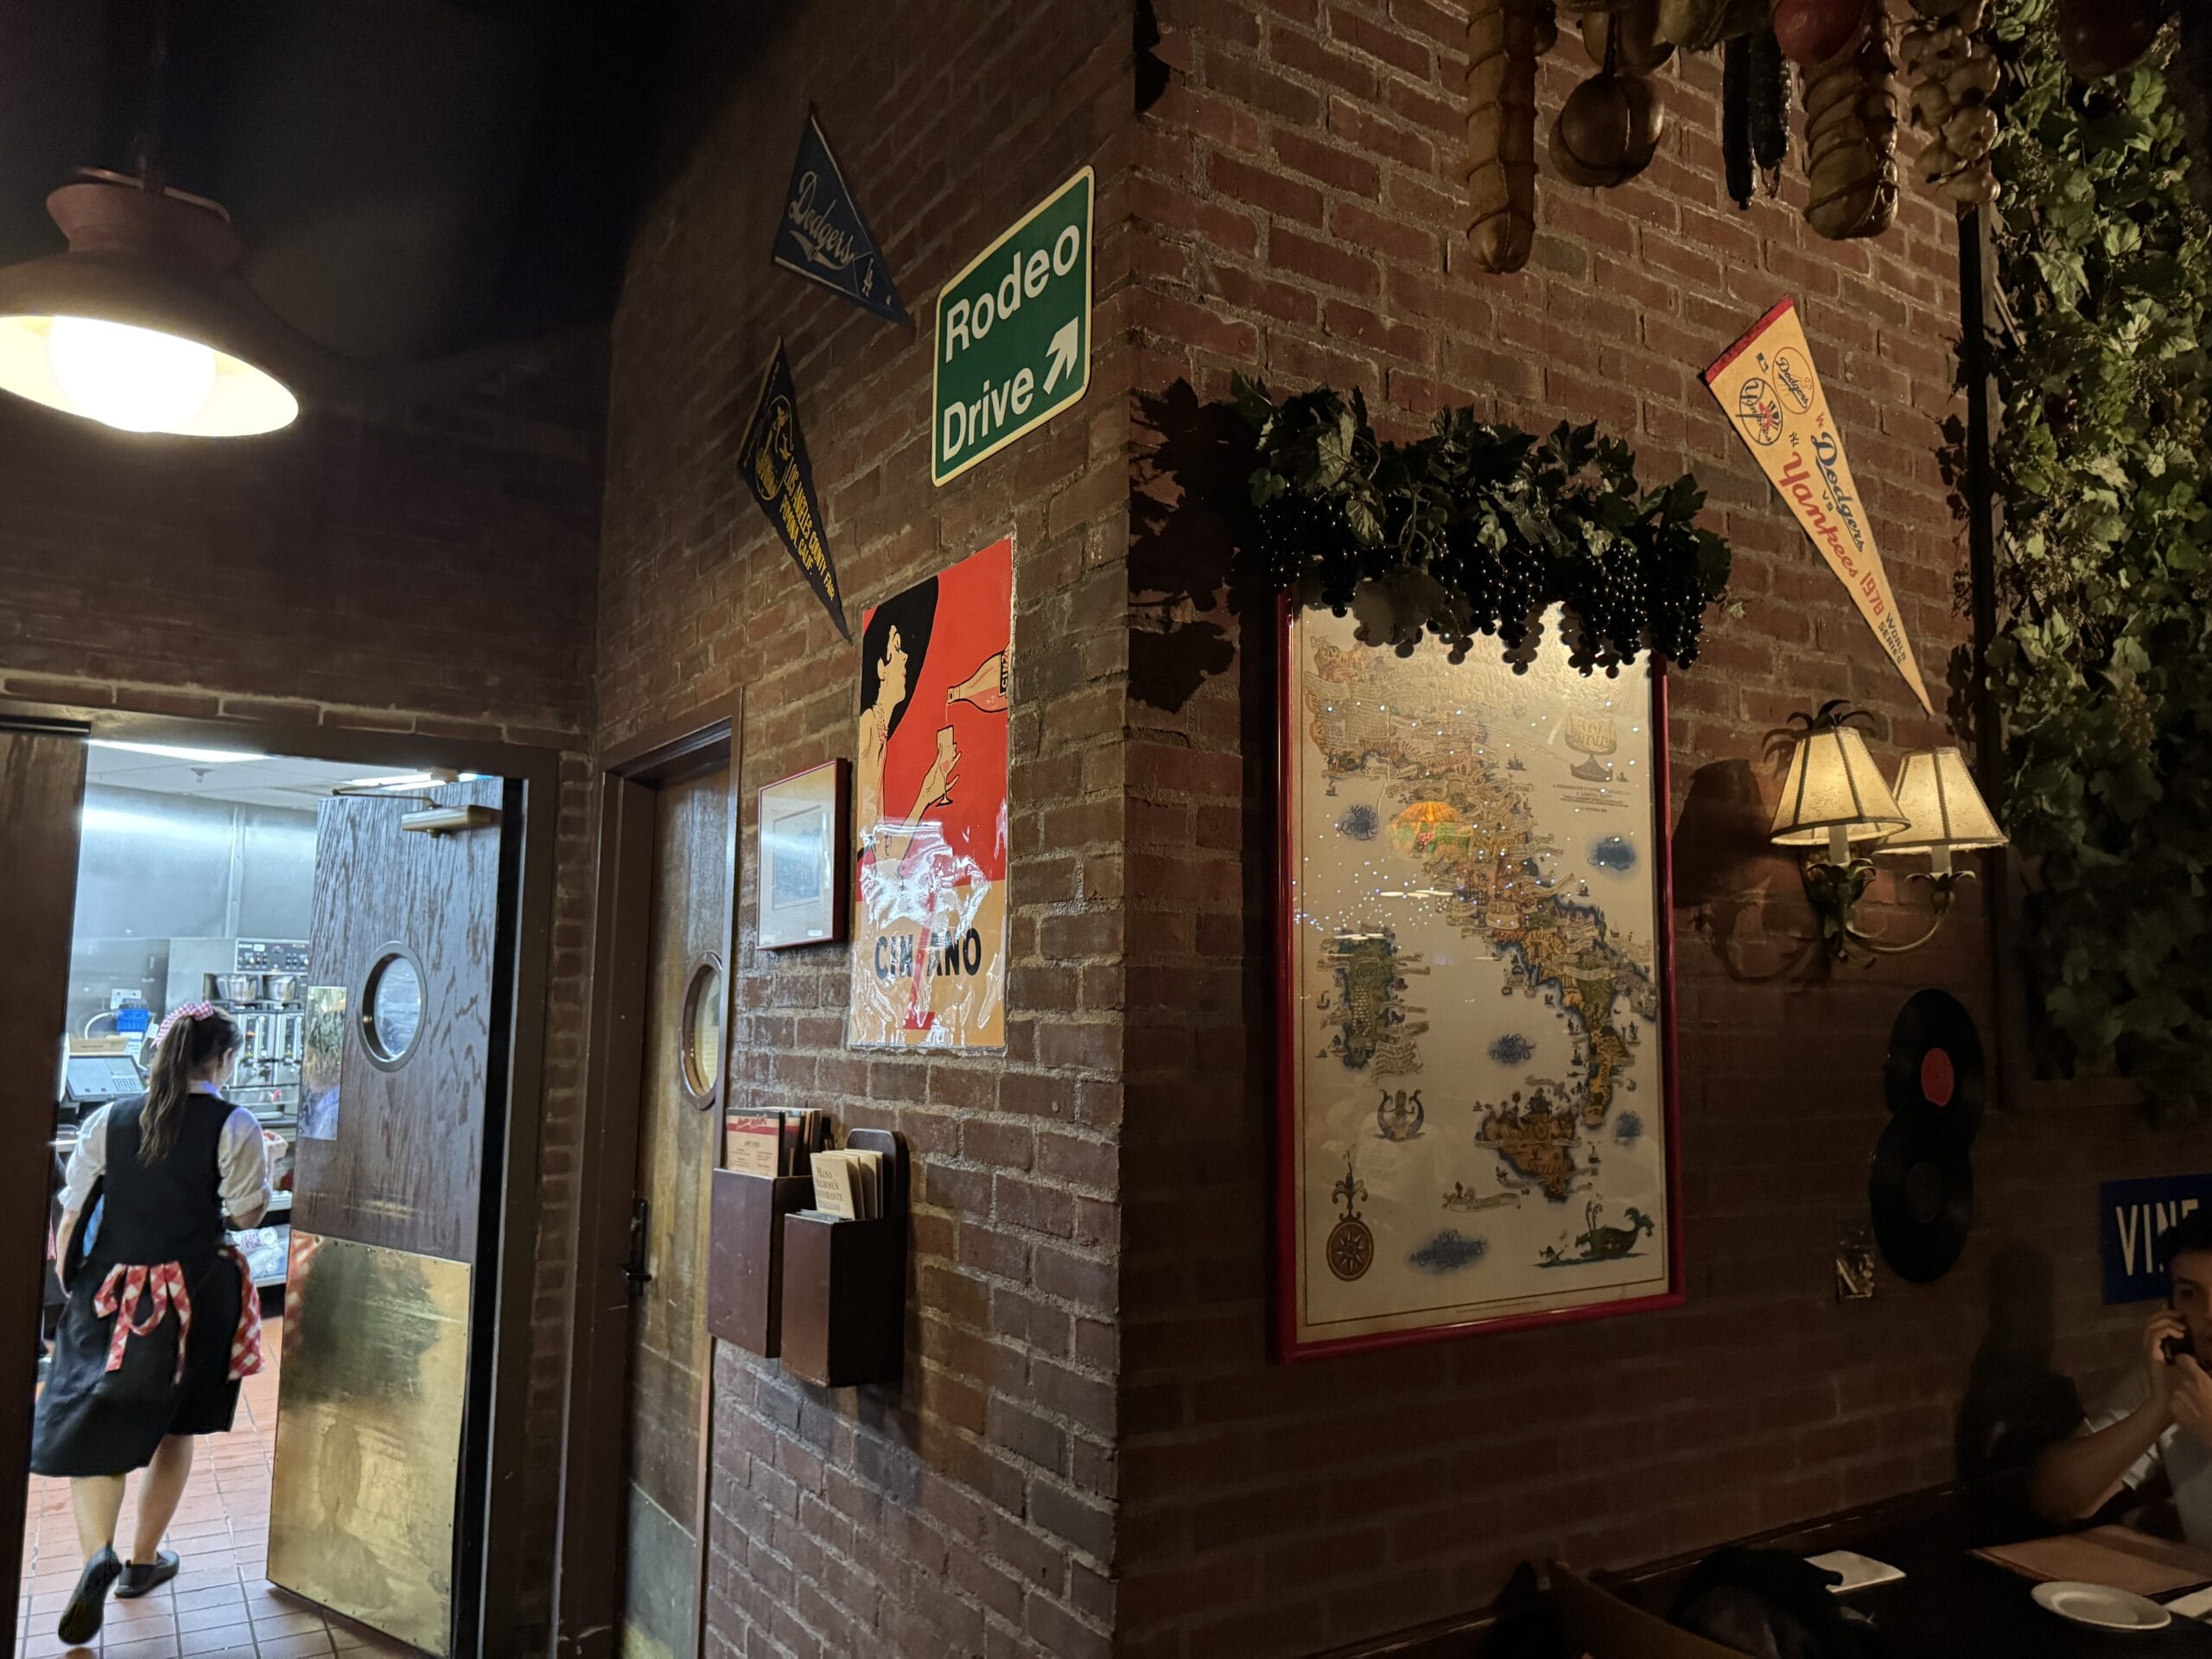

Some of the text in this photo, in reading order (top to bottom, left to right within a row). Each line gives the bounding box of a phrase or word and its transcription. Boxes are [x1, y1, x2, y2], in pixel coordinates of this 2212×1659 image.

[788, 171, 855, 270] Dodgers
[945, 225, 1080, 363] Rodeo
[943, 366, 1034, 462] Drive
[1775, 356, 1808, 409] Dodgers
[784, 456, 835, 601] LOS ANGELES COUNTY FAIR
[1779, 451, 1885, 616] Yankees 1978
[1811, 431, 1864, 553] Dodgers
[1878, 620, 1903, 664] SERIES
[1885, 611, 1907, 661] WORLD
